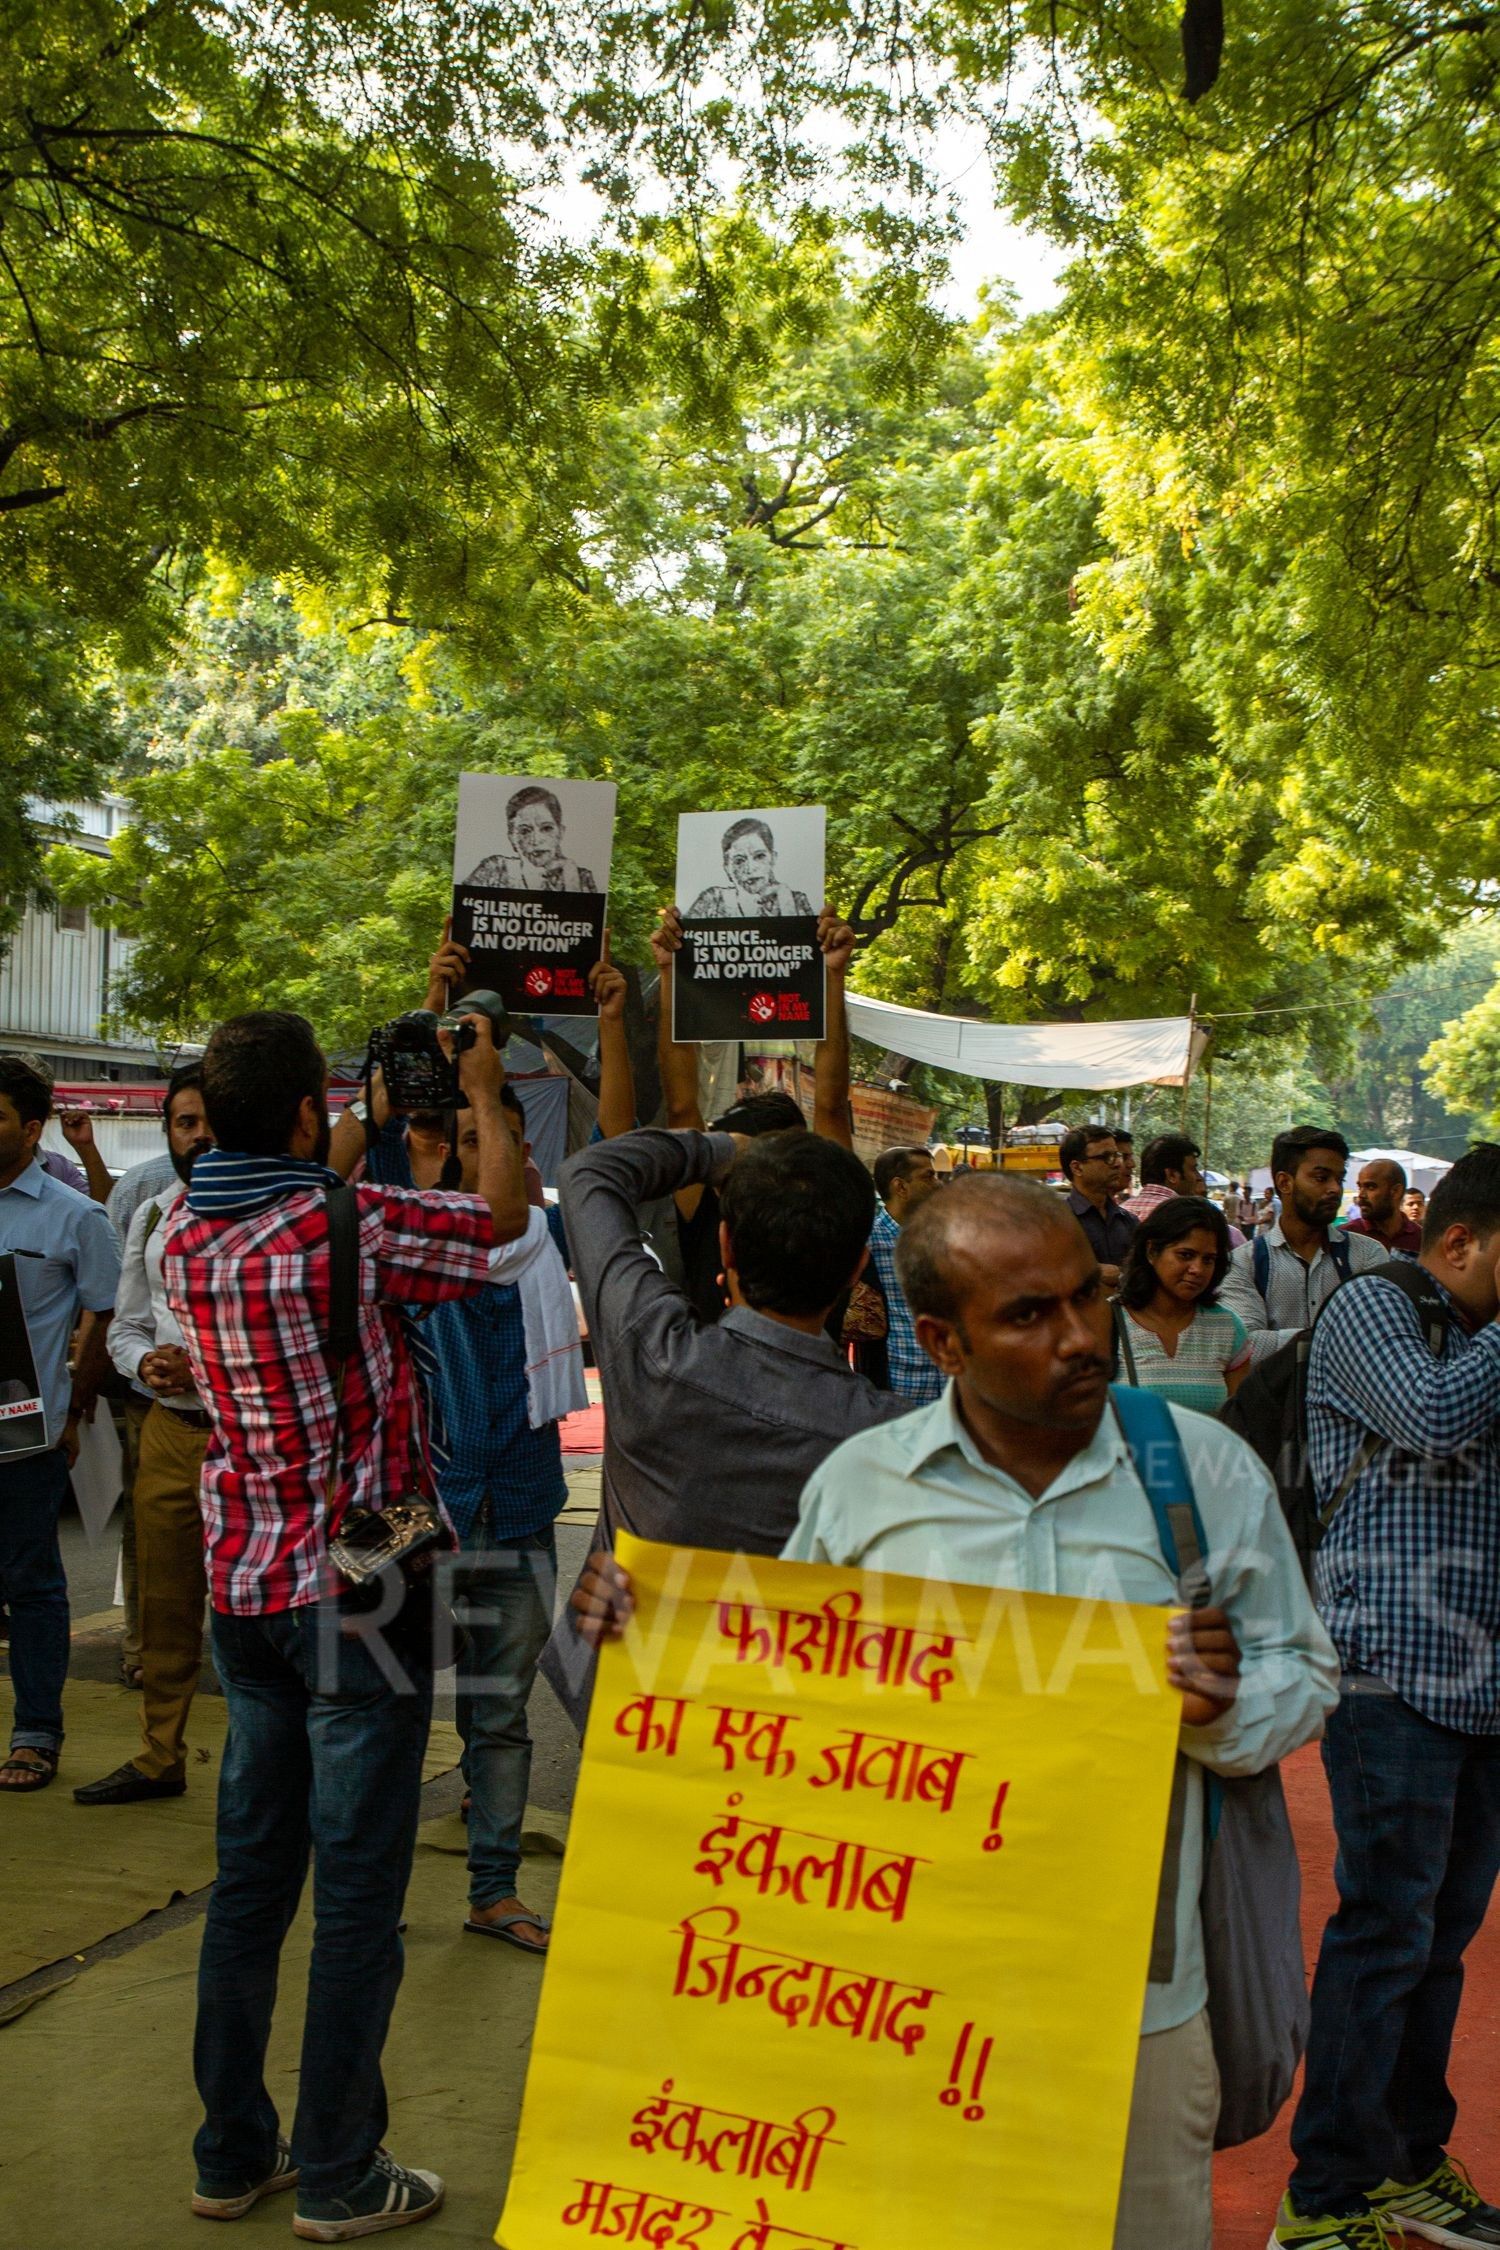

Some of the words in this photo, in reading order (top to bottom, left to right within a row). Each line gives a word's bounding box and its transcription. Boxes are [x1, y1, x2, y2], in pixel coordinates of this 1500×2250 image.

[471, 916, 489, 932] IS
[492, 918, 521, 934] NO
[524, 920, 593, 937] LONGER
[470, 933, 499, 949] AN
[502, 935, 580, 953] OPTION”
[693, 947, 710, 963] IS
[713, 946, 741, 962] NO
[744, 945, 813, 962] LONGER
[693, 964, 720, 979] AN
[723, 961, 801, 978] OPTION”
[554, 987, 585, 997] NAME
[778, 993, 801, 1002] NOT
[778, 1010, 811, 1021] NAME
[8, 1401, 38, 1415] NAME
[614, 1694, 696, 1757] का
[707, 1706, 802, 1777] एक
[807, 1730, 977, 1813] जवाब
[693, 1792, 933, 1923] इंकलाब
